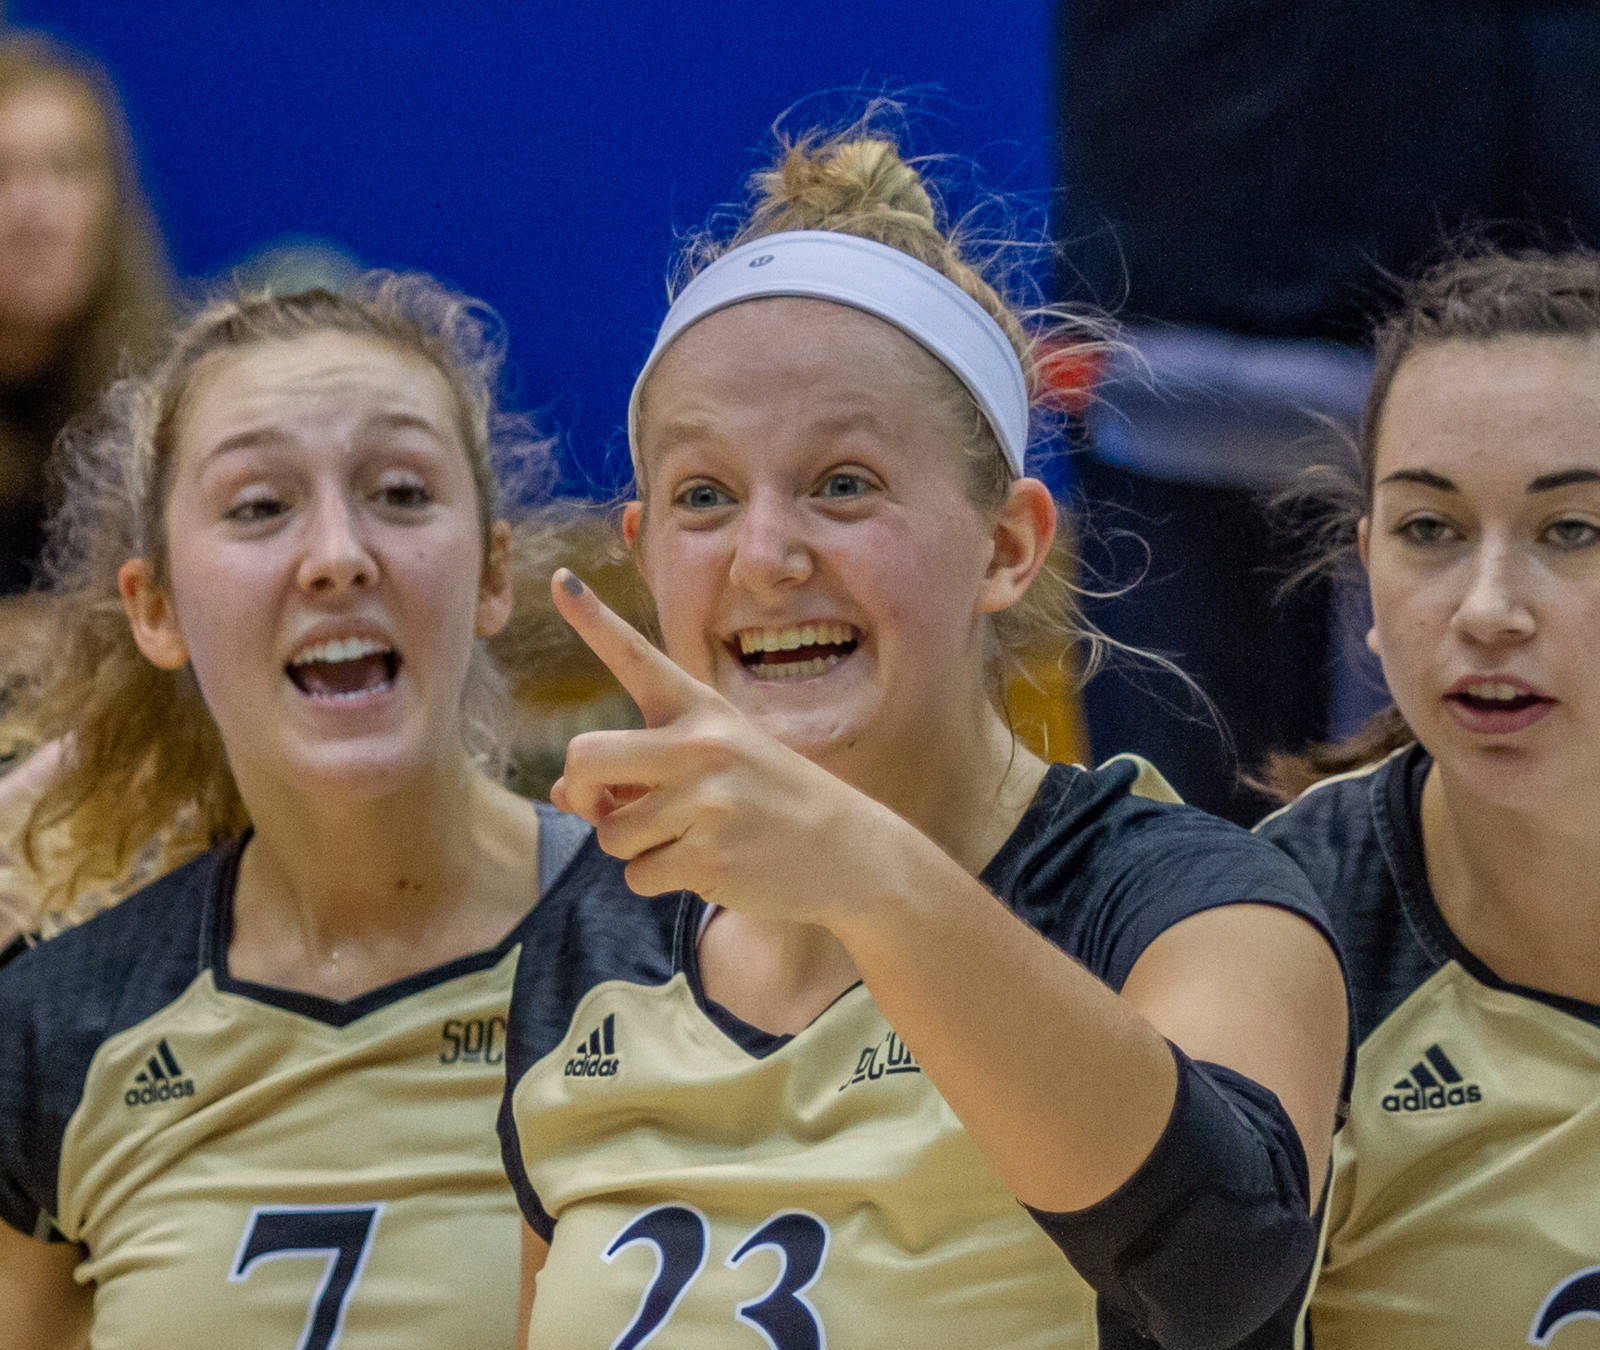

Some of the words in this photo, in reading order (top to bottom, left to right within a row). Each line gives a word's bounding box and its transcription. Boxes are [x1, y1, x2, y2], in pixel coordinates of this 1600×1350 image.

[439, 1016, 507, 1065] SOC
[564, 1051, 620, 1077] adidas
[1381, 1083, 1483, 1113] adidas
